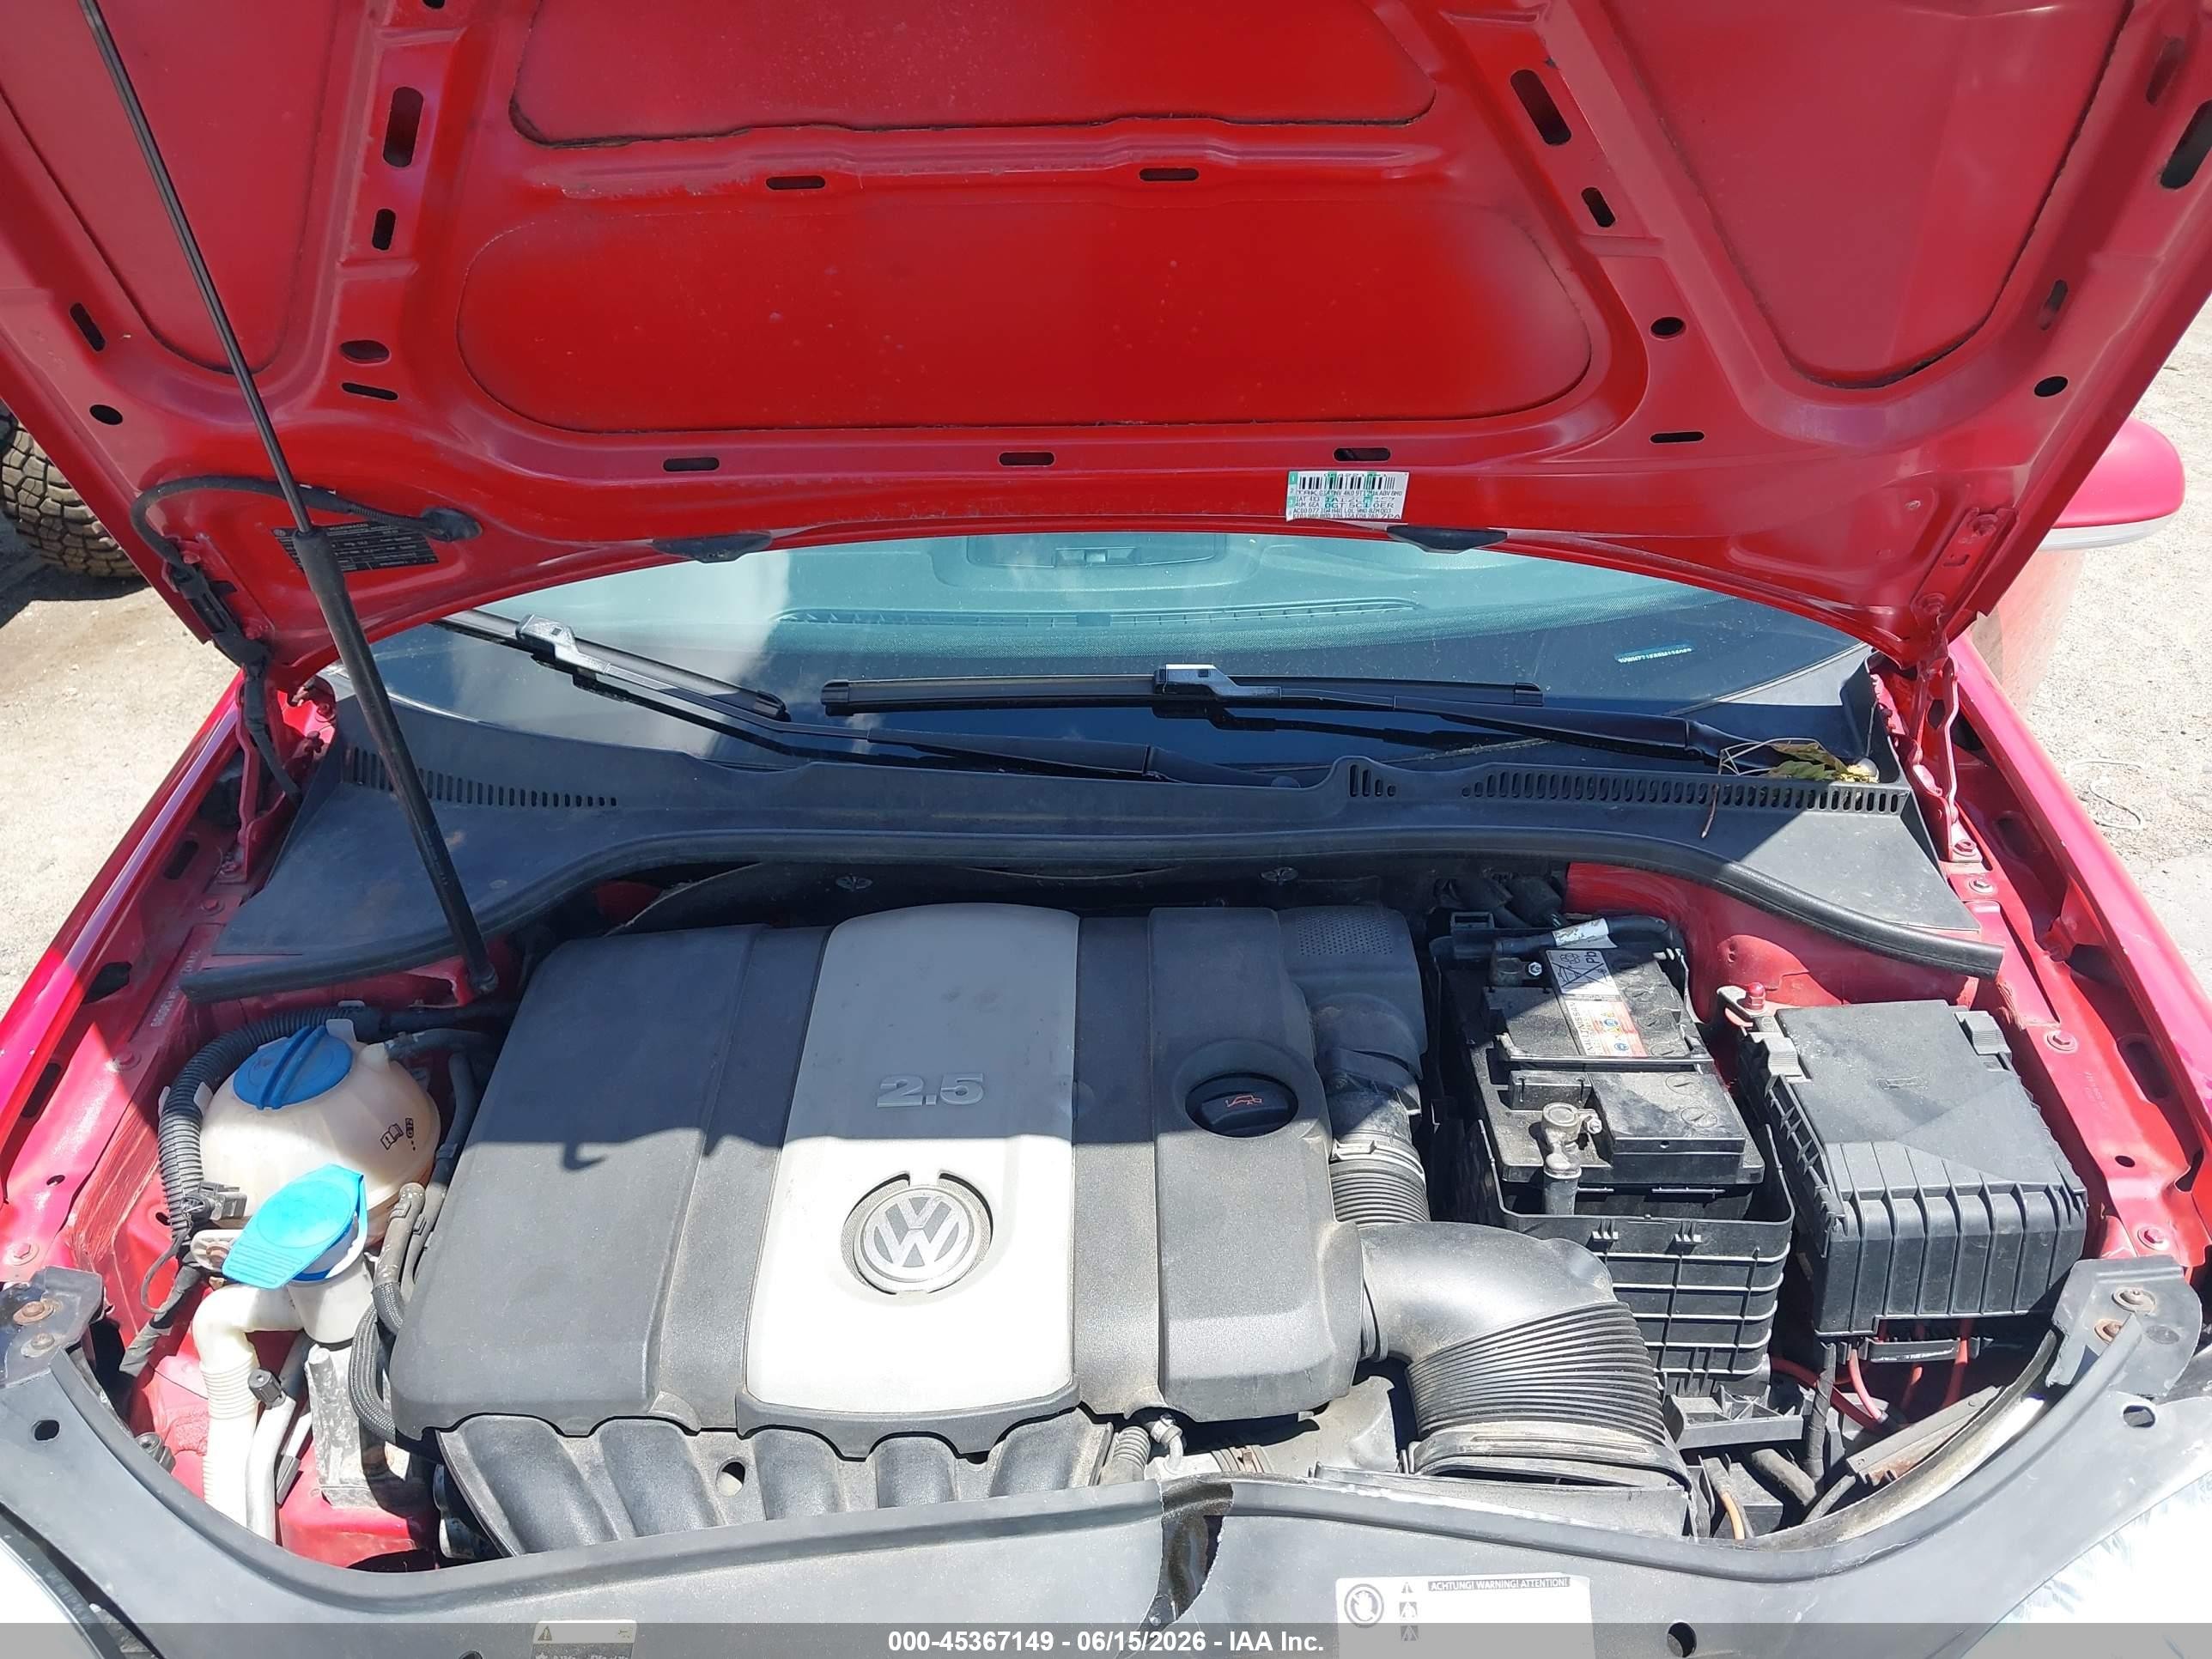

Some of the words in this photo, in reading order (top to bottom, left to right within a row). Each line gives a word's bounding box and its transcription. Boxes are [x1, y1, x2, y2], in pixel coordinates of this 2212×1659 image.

[1584, 951, 1601, 963] Pb
[877, 1073, 984, 1108] 2.5
[1431, 1582, 1474, 1591] ACHTUNG!
[1476, 1580, 1519, 1589] WARNING!
[1521, 1577, 1569, 1588] ATTENTION!
